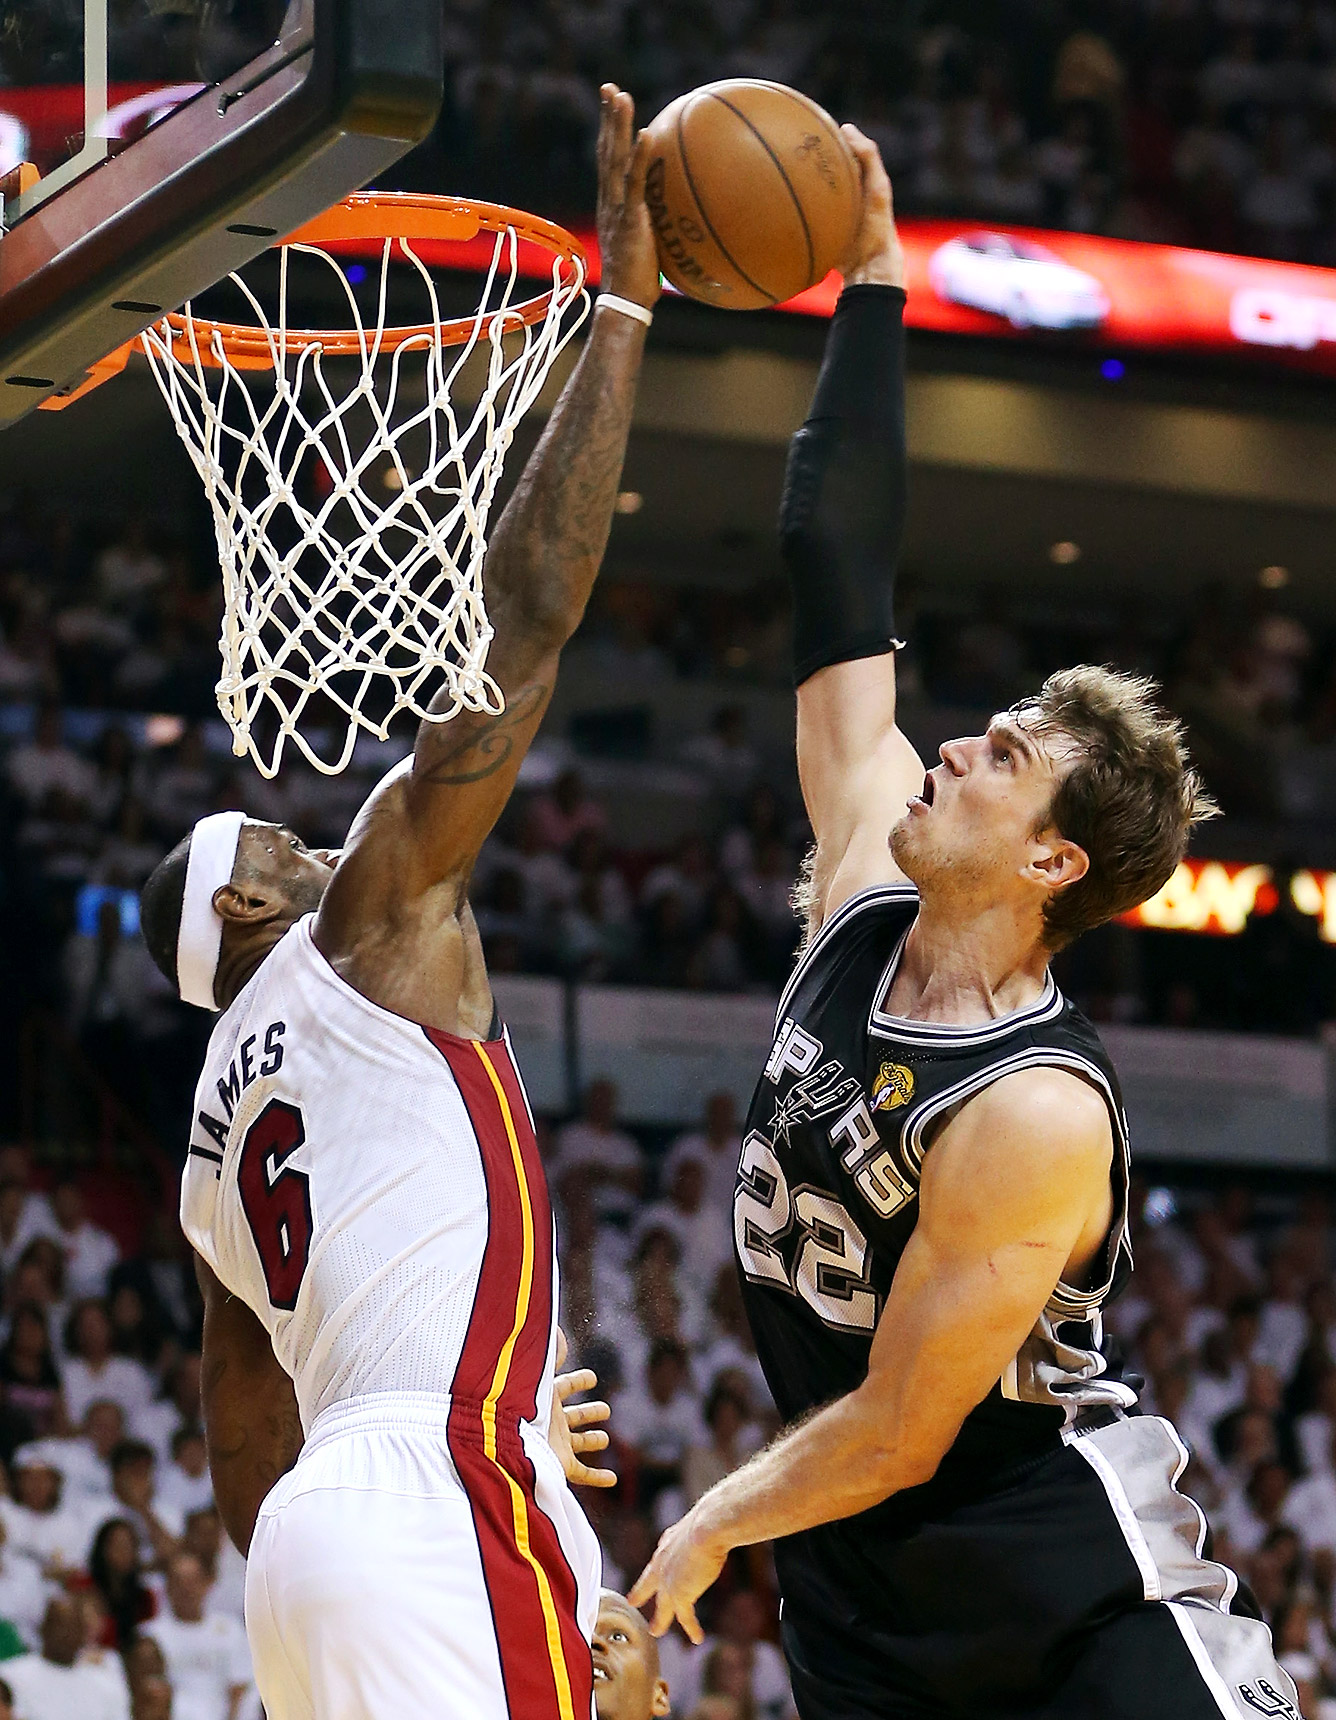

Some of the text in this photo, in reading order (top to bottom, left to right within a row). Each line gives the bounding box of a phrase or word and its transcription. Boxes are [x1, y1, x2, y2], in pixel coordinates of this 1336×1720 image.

[188, 1021, 286, 1181] JAMES
[236, 1097, 314, 1312] 6
[731, 1128, 884, 1337] 22
